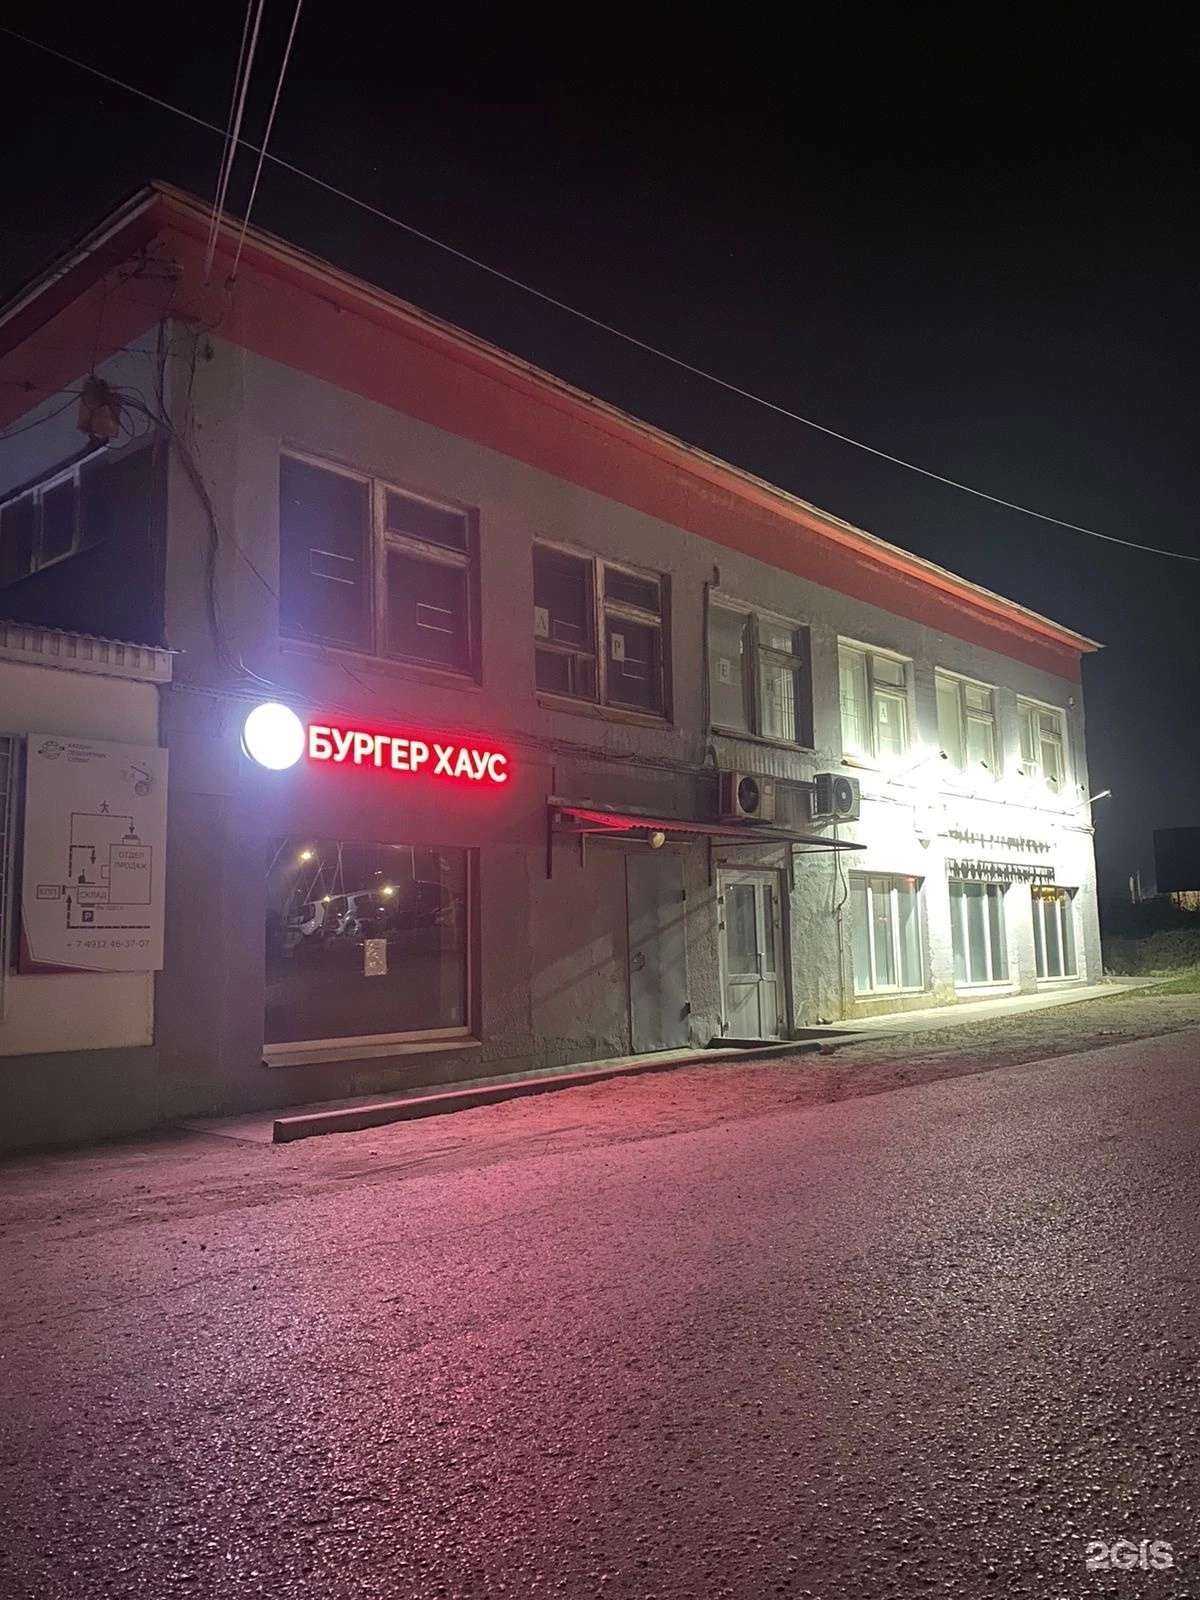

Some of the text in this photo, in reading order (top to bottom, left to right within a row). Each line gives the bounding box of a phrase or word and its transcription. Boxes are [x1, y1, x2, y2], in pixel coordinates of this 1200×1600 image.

[308, 725, 508, 783] БУРГЕР ХАУС
[79, 890, 107, 901] СКЛАД
